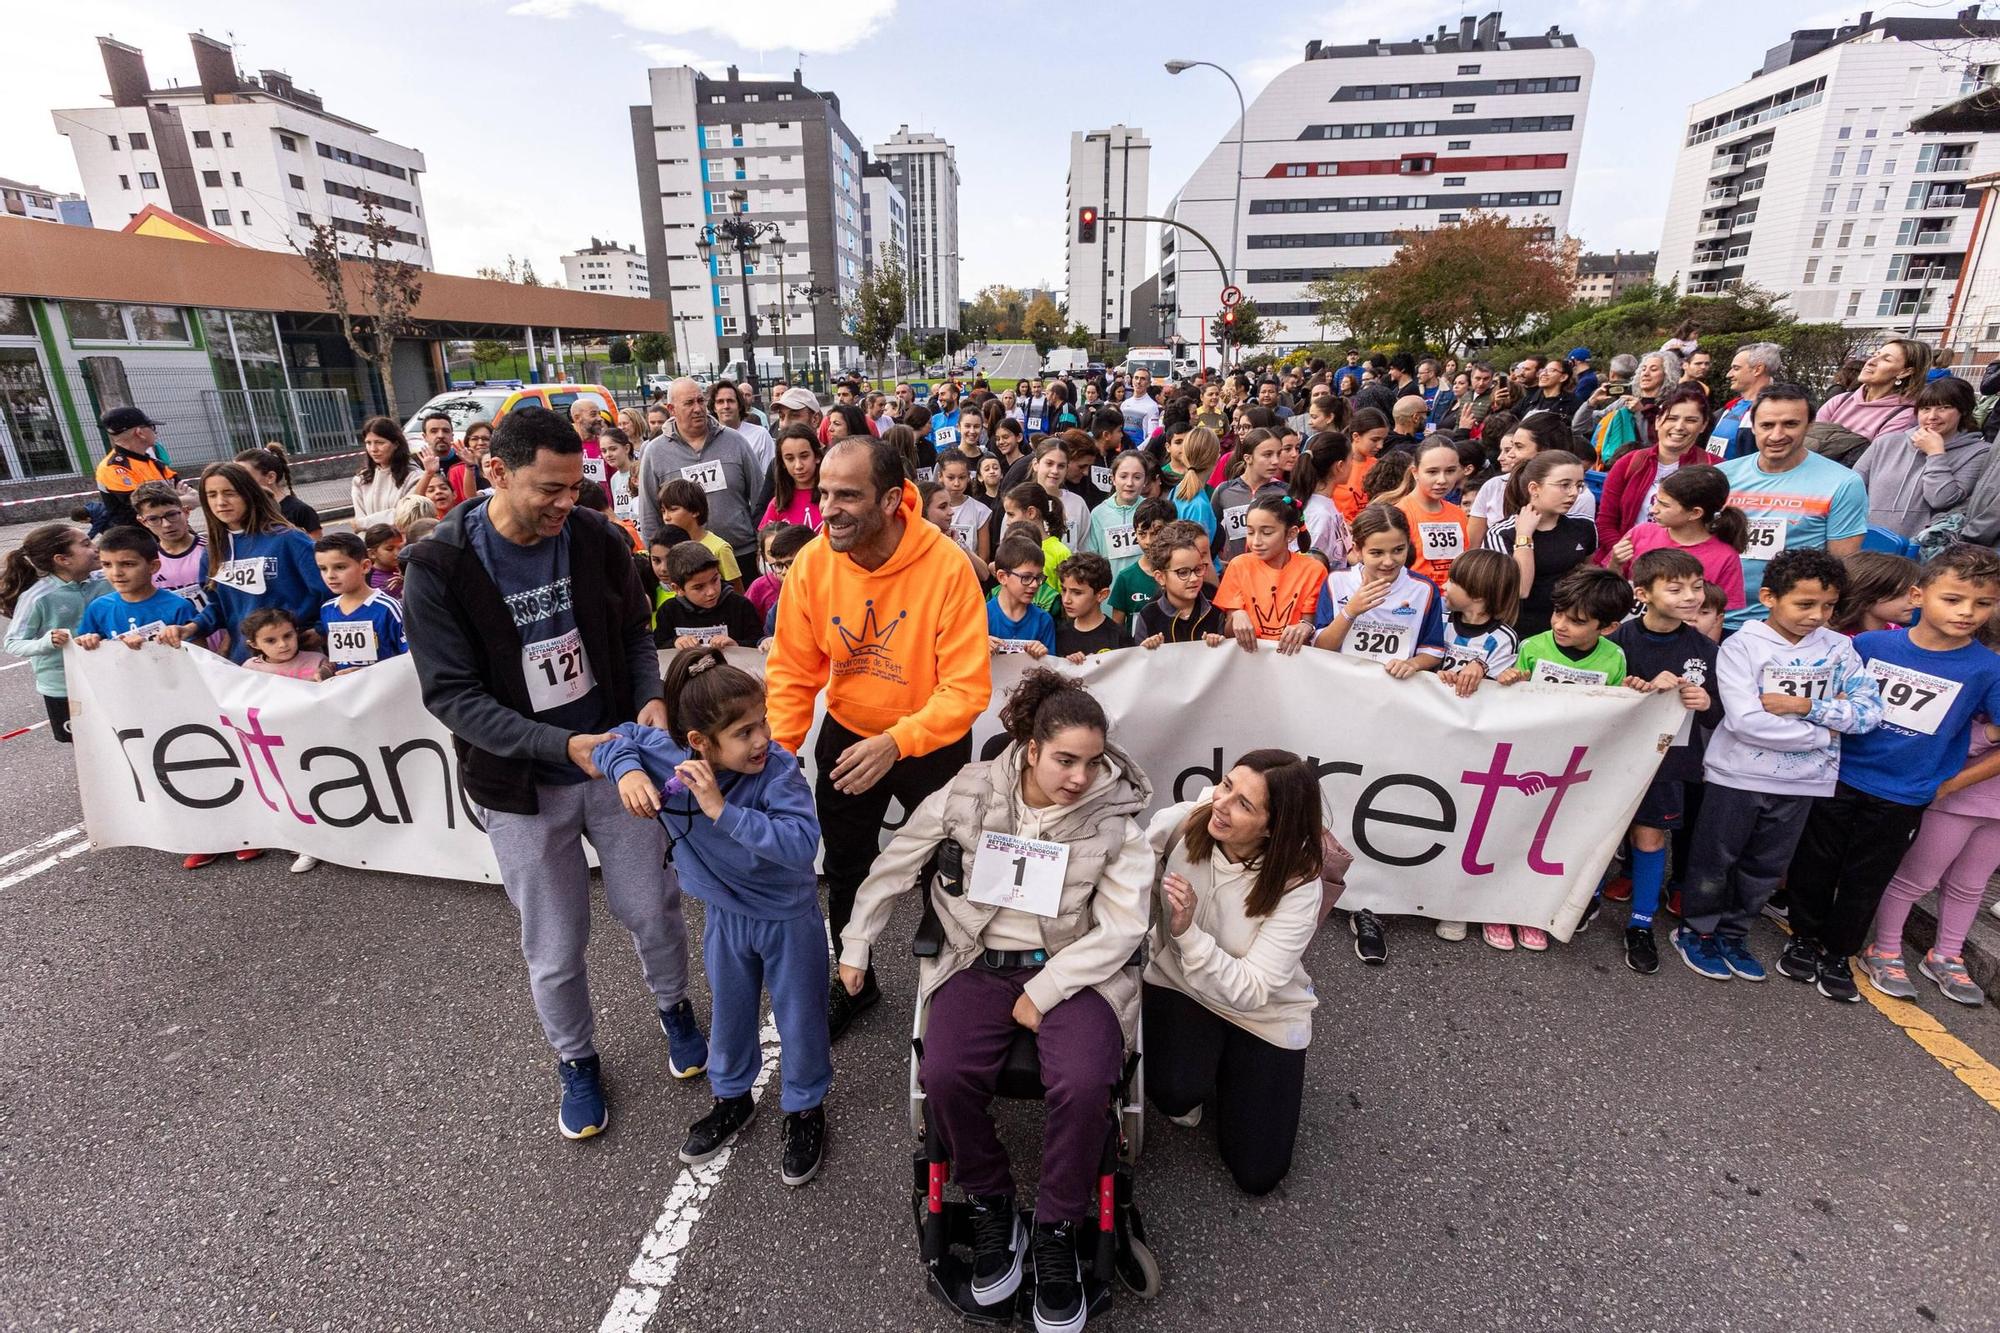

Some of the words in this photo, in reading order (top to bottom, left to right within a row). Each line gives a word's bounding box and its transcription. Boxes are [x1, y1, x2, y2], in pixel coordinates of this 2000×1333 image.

[938, 431, 952, 441] 331
[690, 469, 716, 483] 217
[616, 494, 629, 505] 220
[1231, 515, 1248, 530] 30
[1112, 531, 1139, 549] 312
[1428, 532, 1457, 548] 335
[1748, 528, 1775, 546] 45
[333, 632, 366, 650] 340
[1354, 632, 1399, 655] 320
[539, 646, 583, 687] 127
[1779, 680, 1828, 700] 317
[1876, 678, 1938, 712] 197
[112, 707, 488, 836] rettan
[988, 839, 1019, 848] RETTANDO
[1012, 857, 1026, 886] 1
